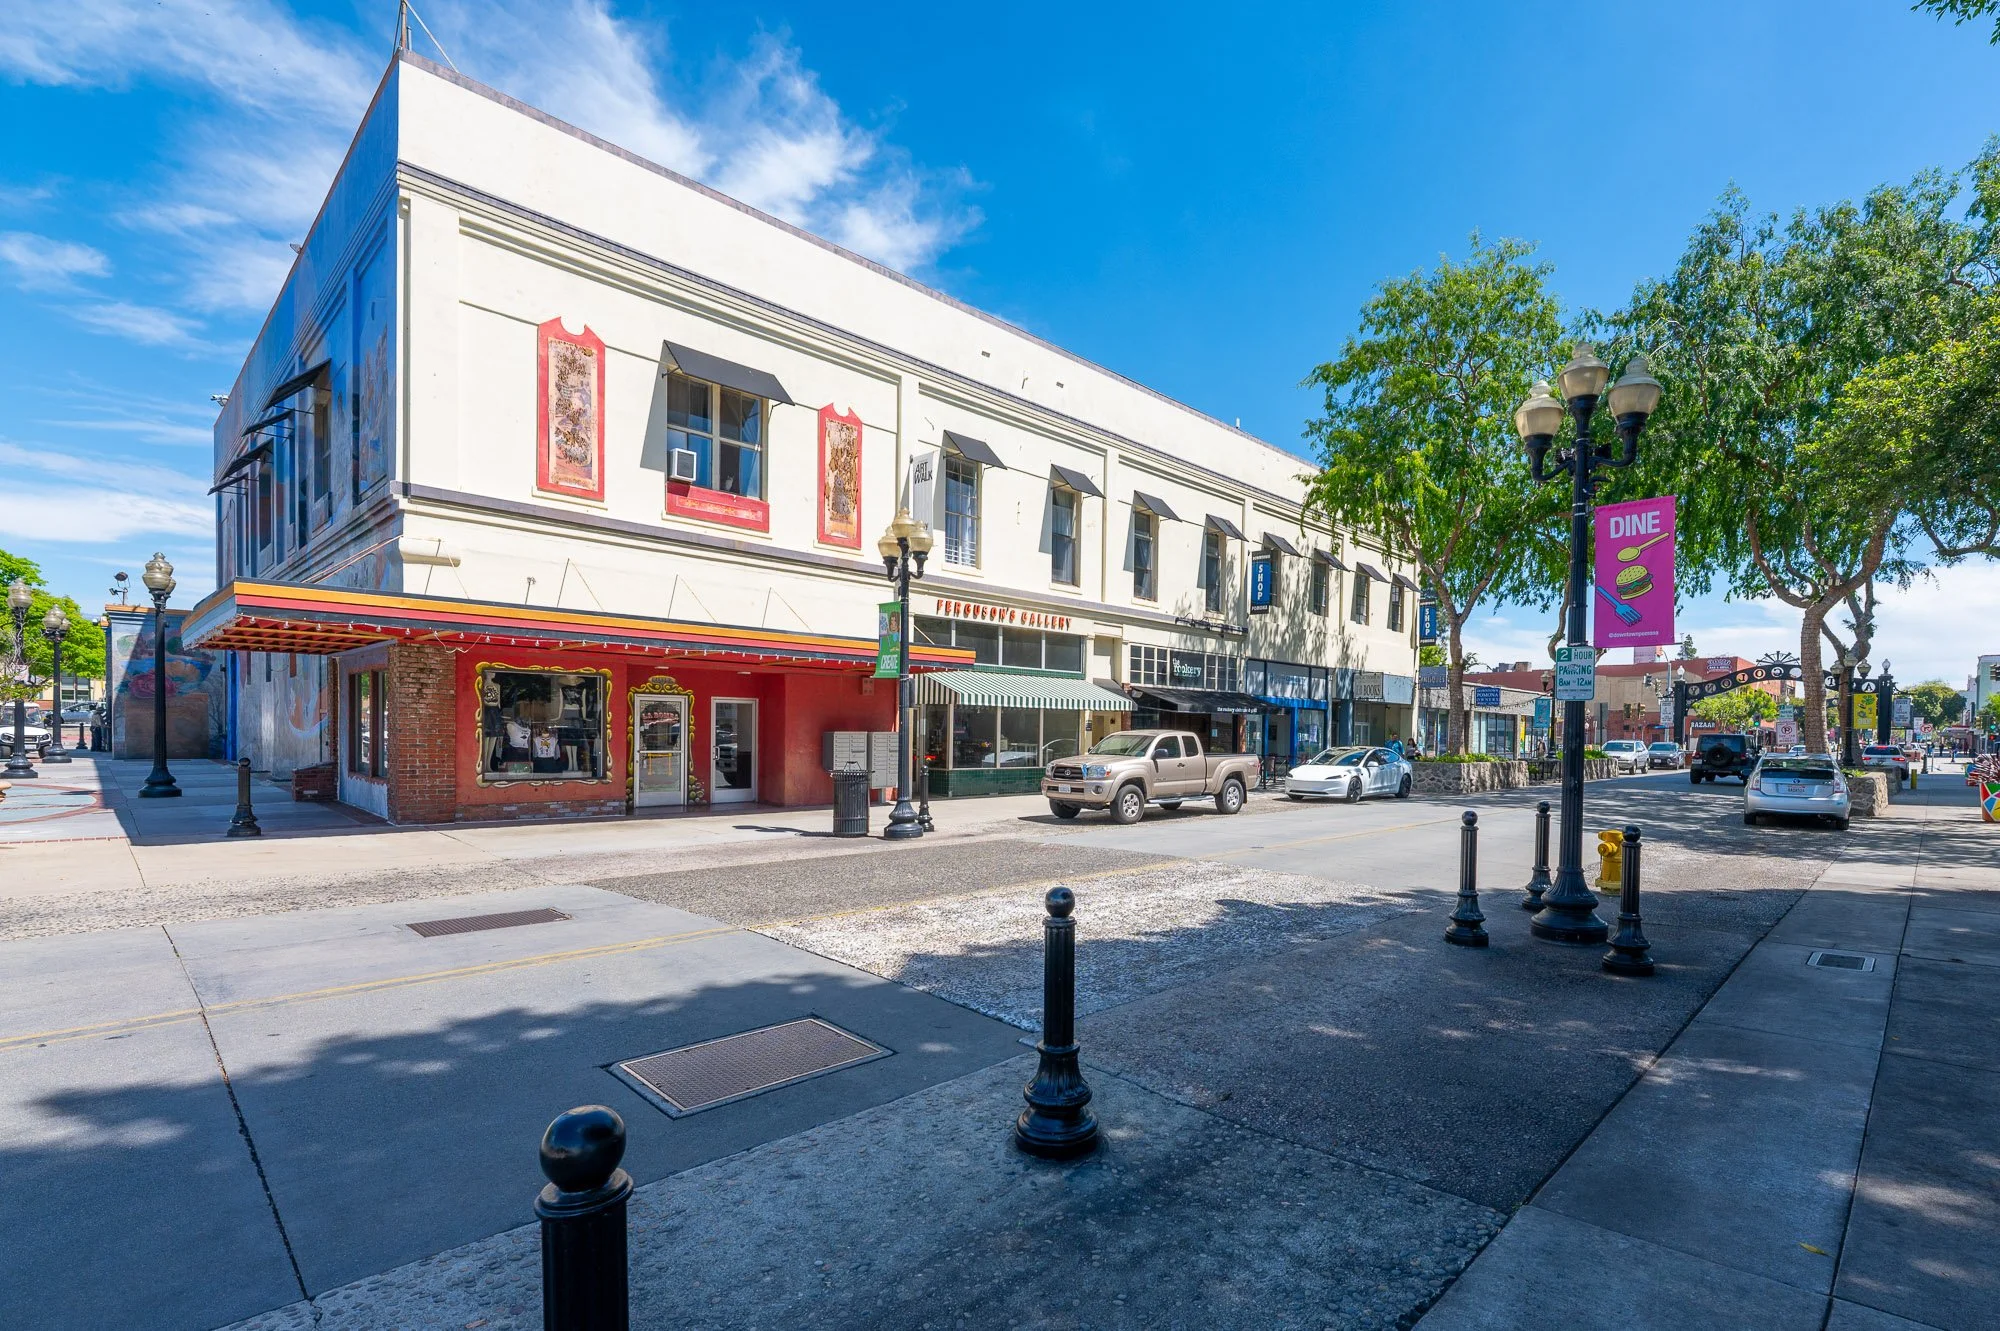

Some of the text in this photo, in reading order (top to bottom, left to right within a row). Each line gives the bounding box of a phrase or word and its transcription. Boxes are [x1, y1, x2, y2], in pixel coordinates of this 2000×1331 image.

[915, 462, 928, 474] ART
[914, 470, 933, 484] WALK
[1610, 511, 1660, 538] DINE
[936, 599, 1072, 631] FERGUSON'S GALLERY
[881, 655, 898, 669] CREATE
[1561, 650, 1593, 660] 2 HOUR
[1174, 664, 1202, 678] rookery
[1558, 678, 1570, 686] 8AM
[1577, 678, 1592, 686] 12AM
